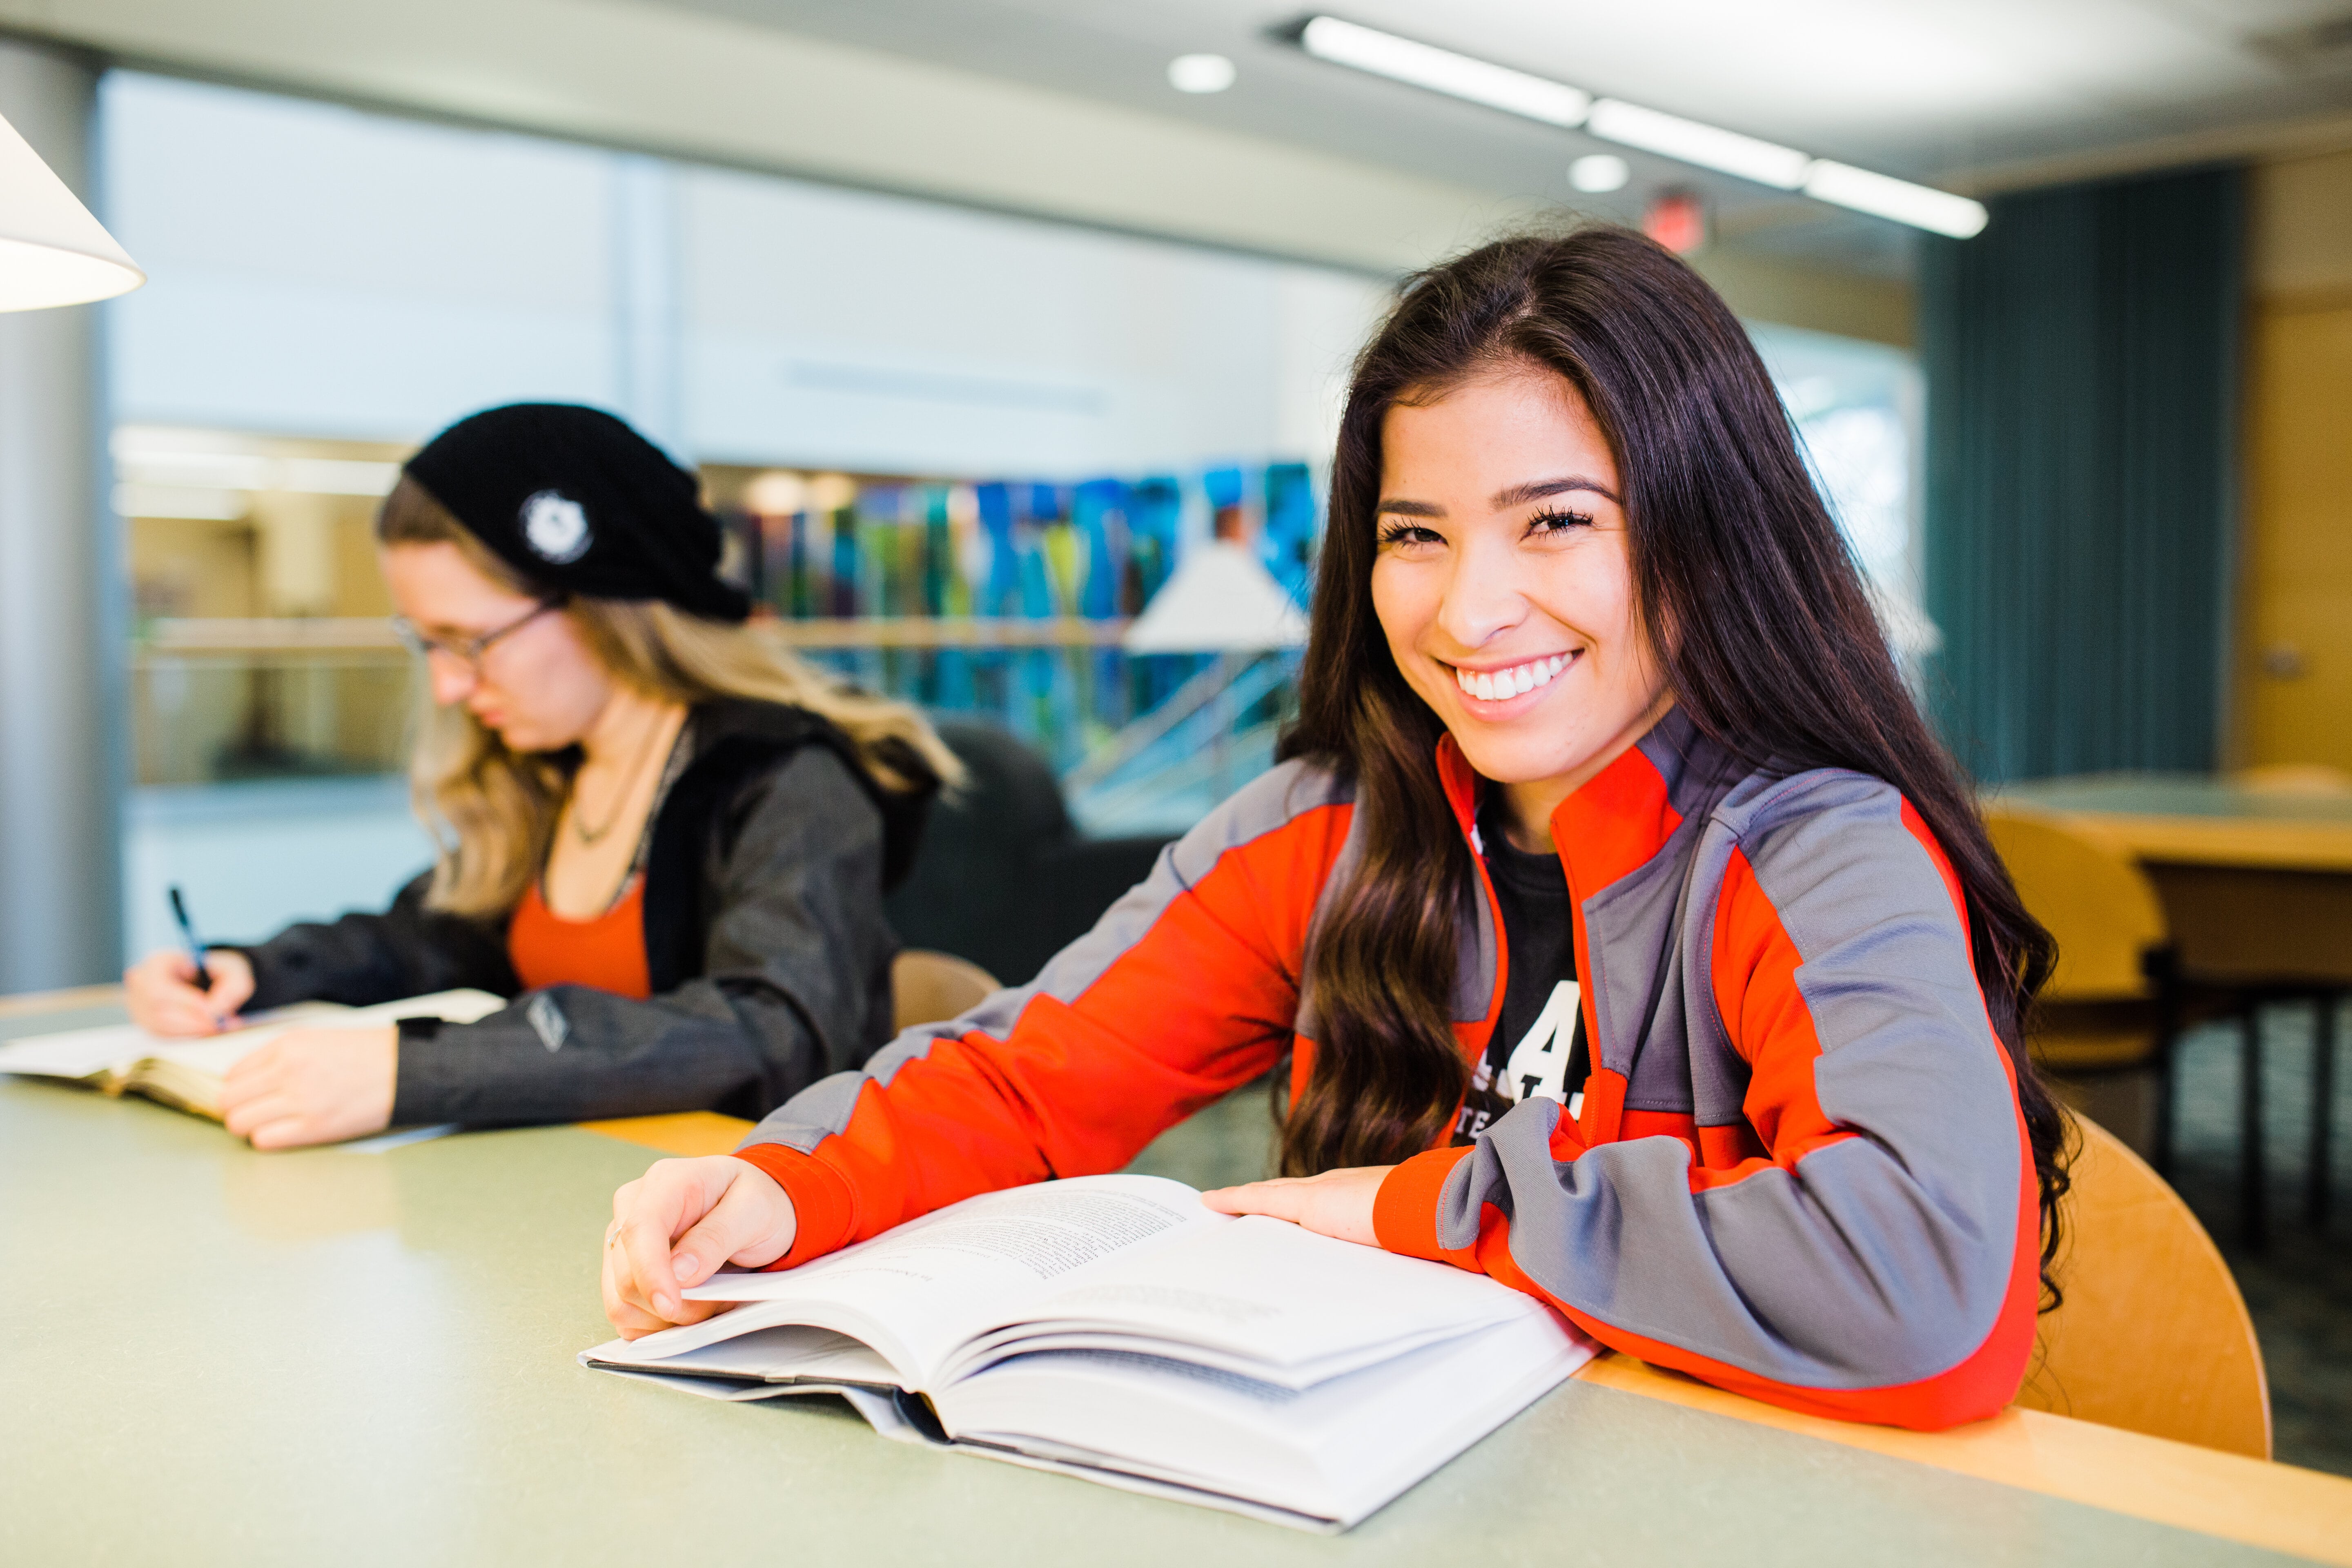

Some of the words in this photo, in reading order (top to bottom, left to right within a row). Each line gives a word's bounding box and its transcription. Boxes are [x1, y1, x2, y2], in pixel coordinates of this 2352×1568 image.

[1023, 1238, 1050, 1250] someone
[1040, 1240, 1067, 1254] enjoying
[1095, 1238, 1116, 1251] section
[1027, 1245, 1054, 1258] anything
[1035, 1252, 1054, 1263] could
[1051, 1249, 1079, 1267] generally,
[1054, 1257, 1071, 1270] seeing
